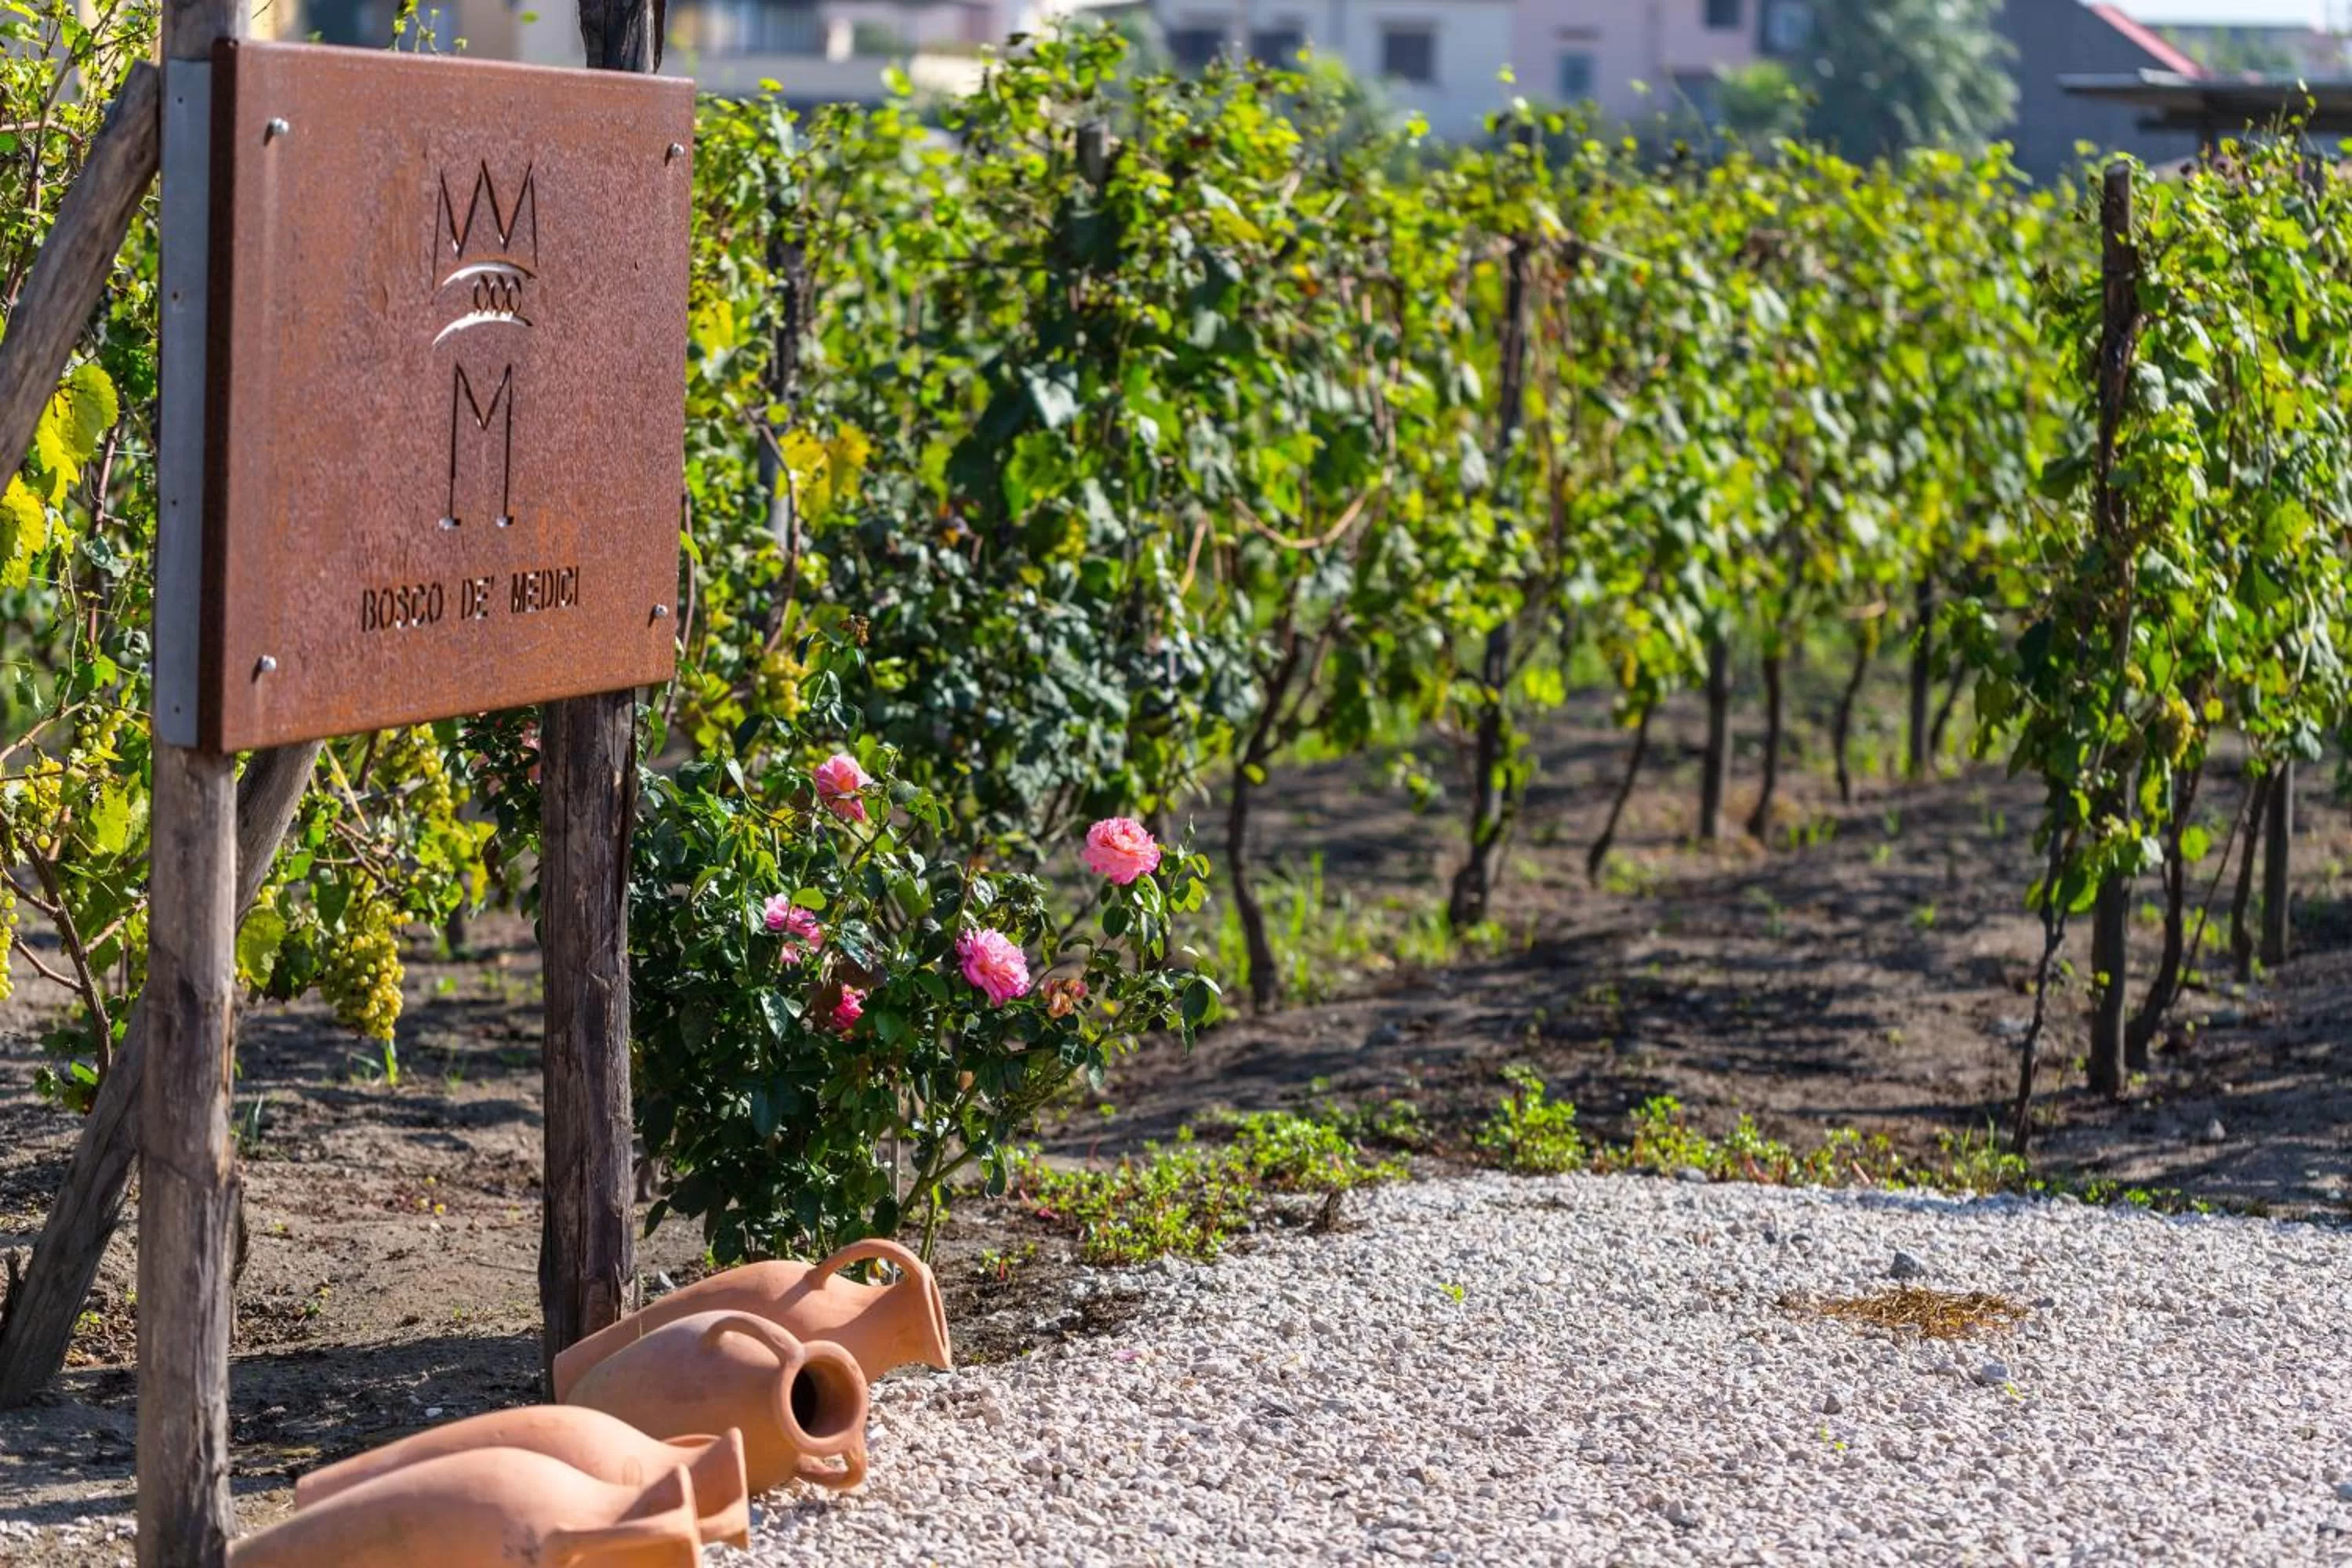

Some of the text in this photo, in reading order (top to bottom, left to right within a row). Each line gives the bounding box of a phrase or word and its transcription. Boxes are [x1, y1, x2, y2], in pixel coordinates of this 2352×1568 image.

[361, 565, 579, 632] BOSCO DE' MEDICI
